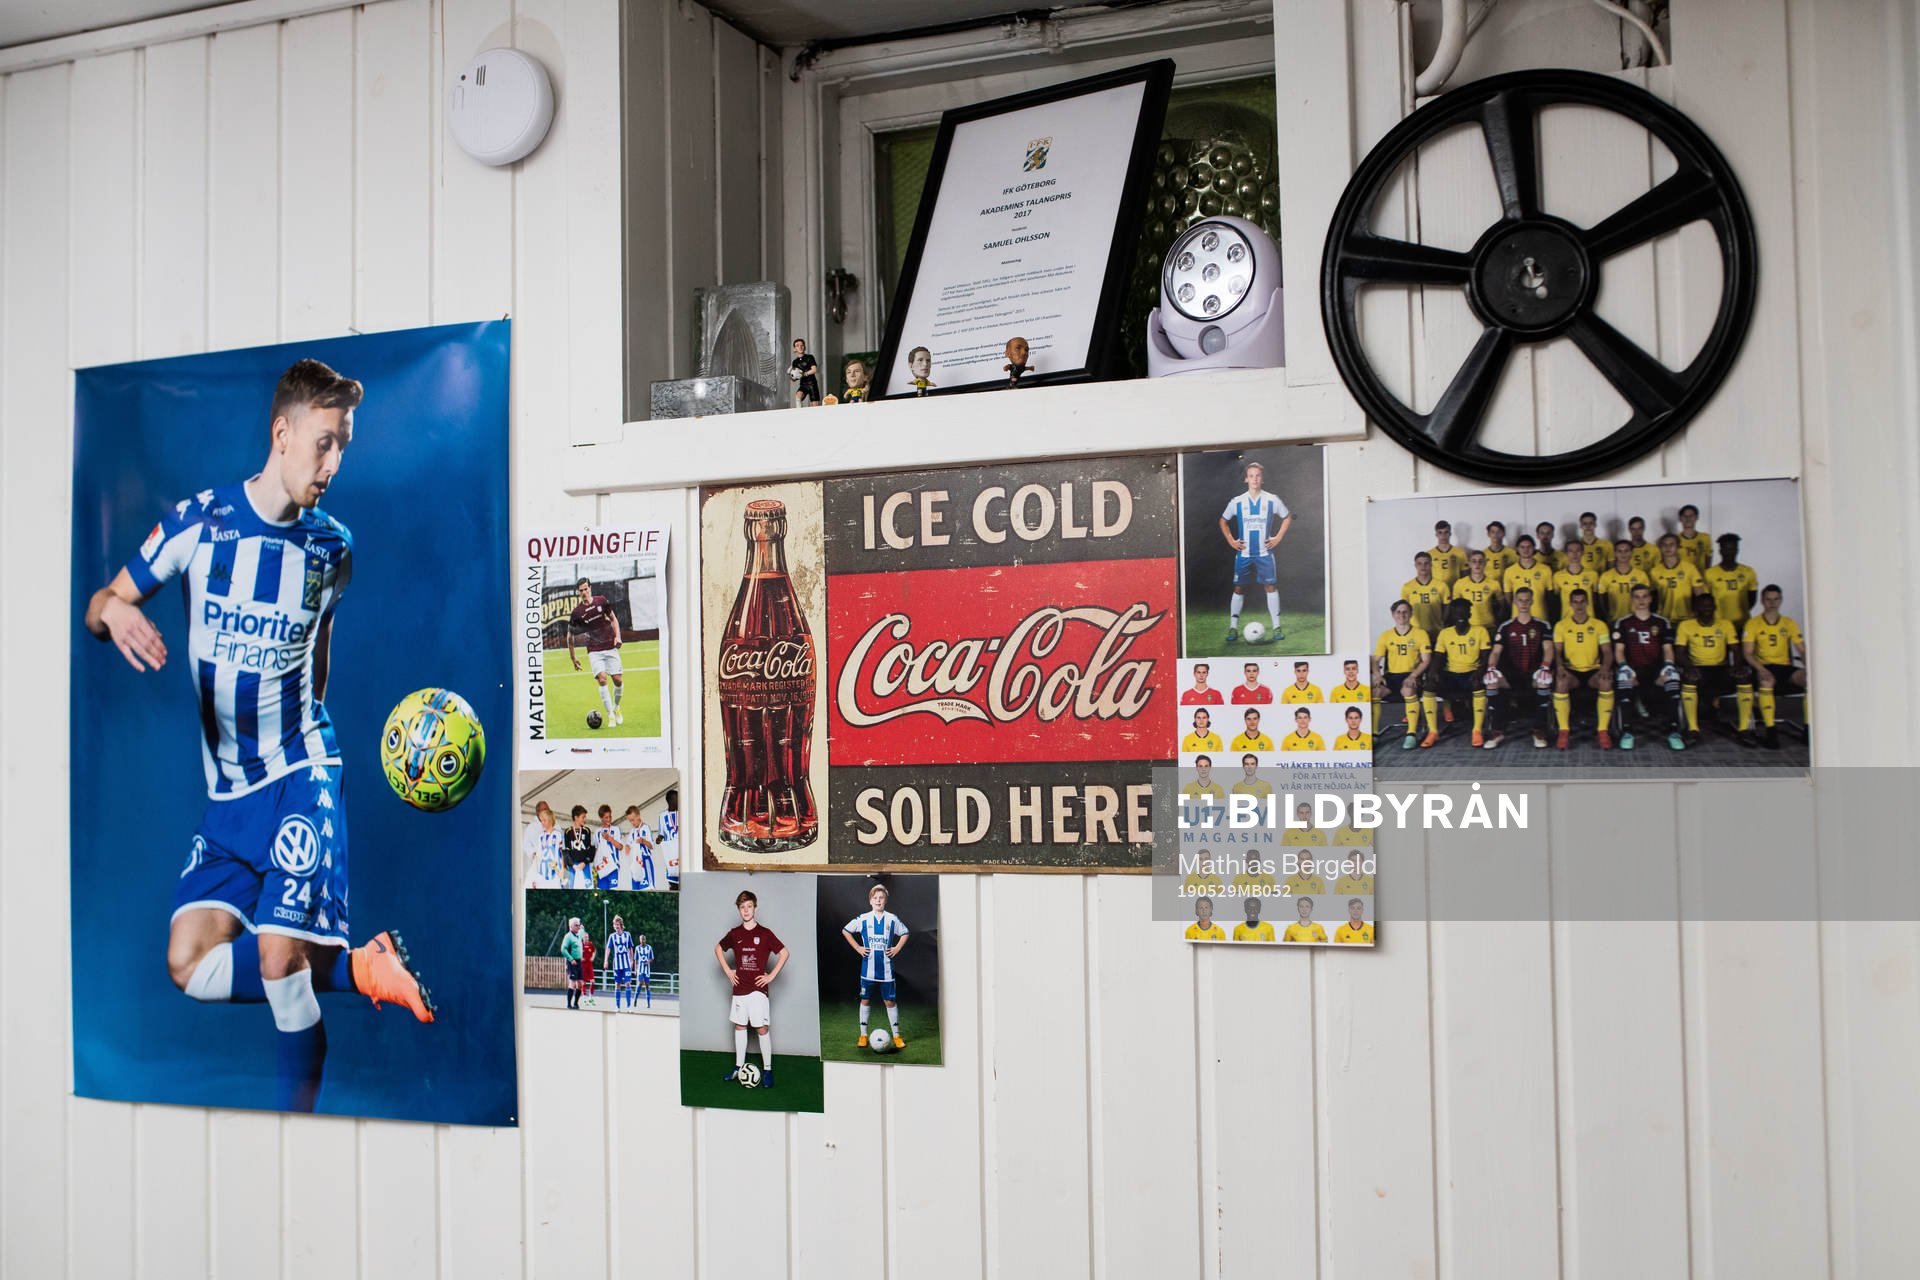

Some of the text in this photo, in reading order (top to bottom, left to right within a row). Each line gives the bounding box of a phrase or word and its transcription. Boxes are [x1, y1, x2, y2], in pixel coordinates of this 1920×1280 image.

[1003, 179, 1056, 195] IFK GÖTEBORG
[980, 192, 1072, 216] AKADEMINS TALANGPRIS
[1013, 209, 1032, 219] 2017
[983, 231, 1051, 250] SAMUEL OHLSSON
[863, 480, 1133, 550] ICE COLD
[304, 535, 330, 561] RASTA
[1472, 591, 1483, 602] 13
[541, 596, 582, 623] OPPAR
[1521, 634, 1527, 646] 1
[1577, 632, 1584, 643] 8
[1638, 631, 1650, 644] 12
[1702, 635, 1715, 648] 15
[213, 632, 291, 670] Finans
[526, 565, 544, 740] MATCHPROGRAM
[1458, 643, 1467, 655] 11
[720, 641, 813, 679] Coca-Cola
[838, 602, 1168, 728] Coca-Cola
[743, 681, 767, 690] MARK
[955, 702, 971, 711] MARK
[1293, 771, 1309, 779] FÖR
[1324, 782, 1351, 790] NÖJDA
[855, 784, 1155, 845] SOLD HERE
[1183, 832, 1273, 843] MAGASIN
[282, 878, 312, 908] 24
[273, 906, 312, 924] Kapp
